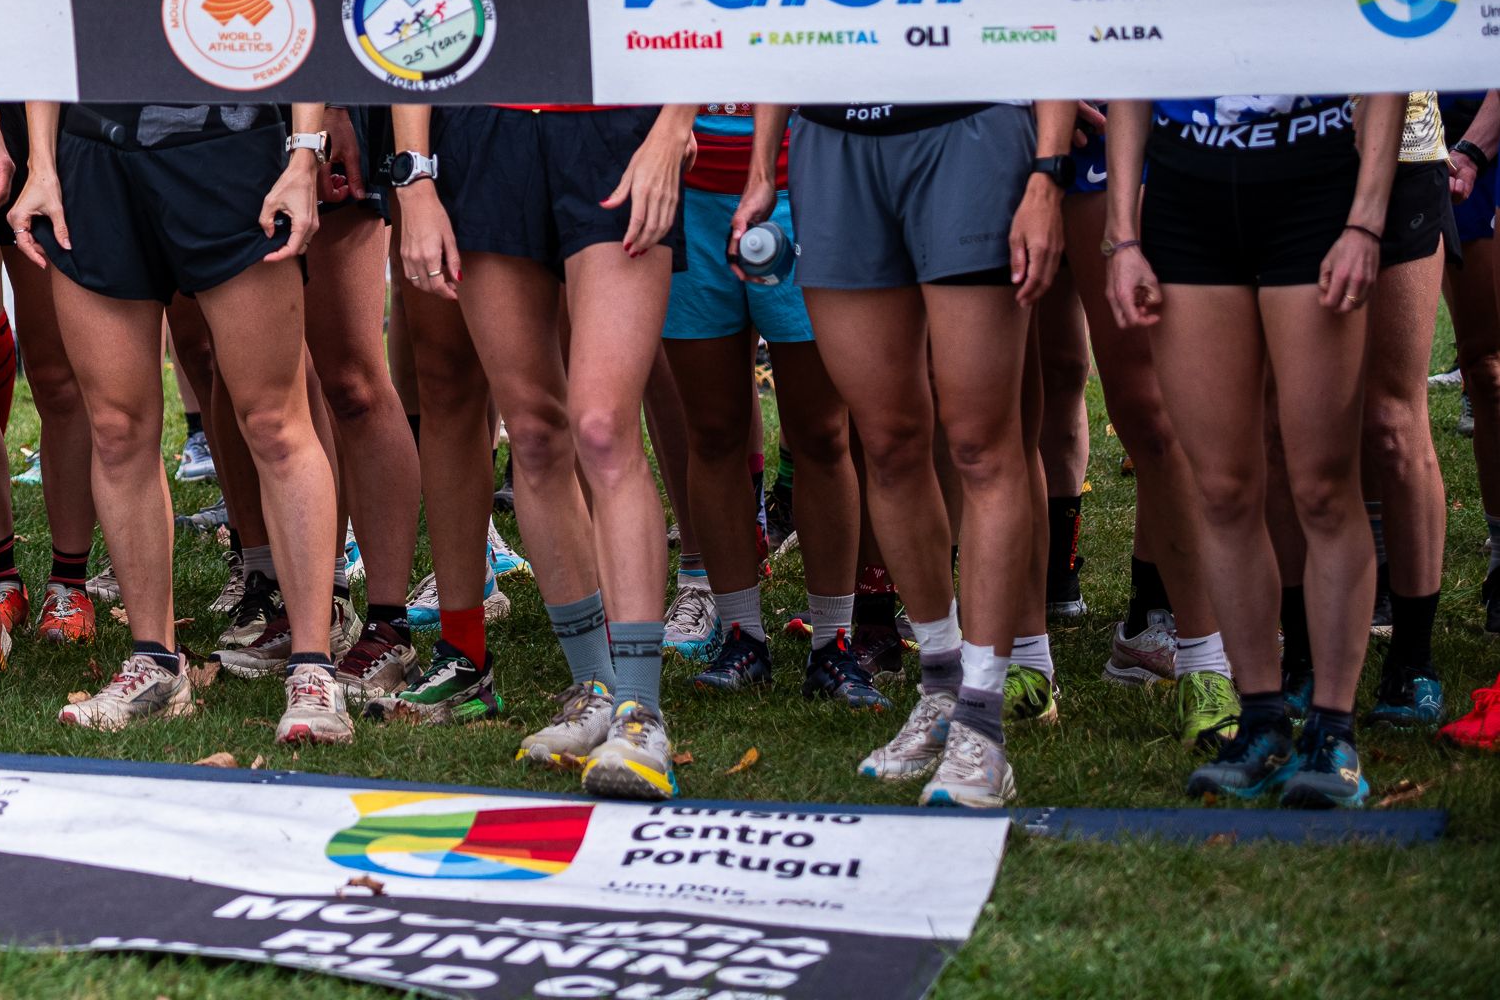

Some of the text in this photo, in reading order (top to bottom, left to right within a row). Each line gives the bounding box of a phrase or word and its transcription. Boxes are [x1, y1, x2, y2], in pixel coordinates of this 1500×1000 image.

[218, 32, 262, 41] WORLD
[626, 29, 723, 50] fondital
[769, 30, 878, 46] RAFFMETAL
[905, 26, 950, 47] OLI
[982, 29, 1057, 43] MARVON
[209, 42, 273, 52] ATHLETICS
[402, 30, 467, 66] 25 Years
[845, 104, 894, 121] PORT
[1179, 121, 1279, 148] NIKE
[631, 821, 815, 848] Centro
[620, 848, 862, 879] Portugal
[261, 929, 798, 989] RUNNING
